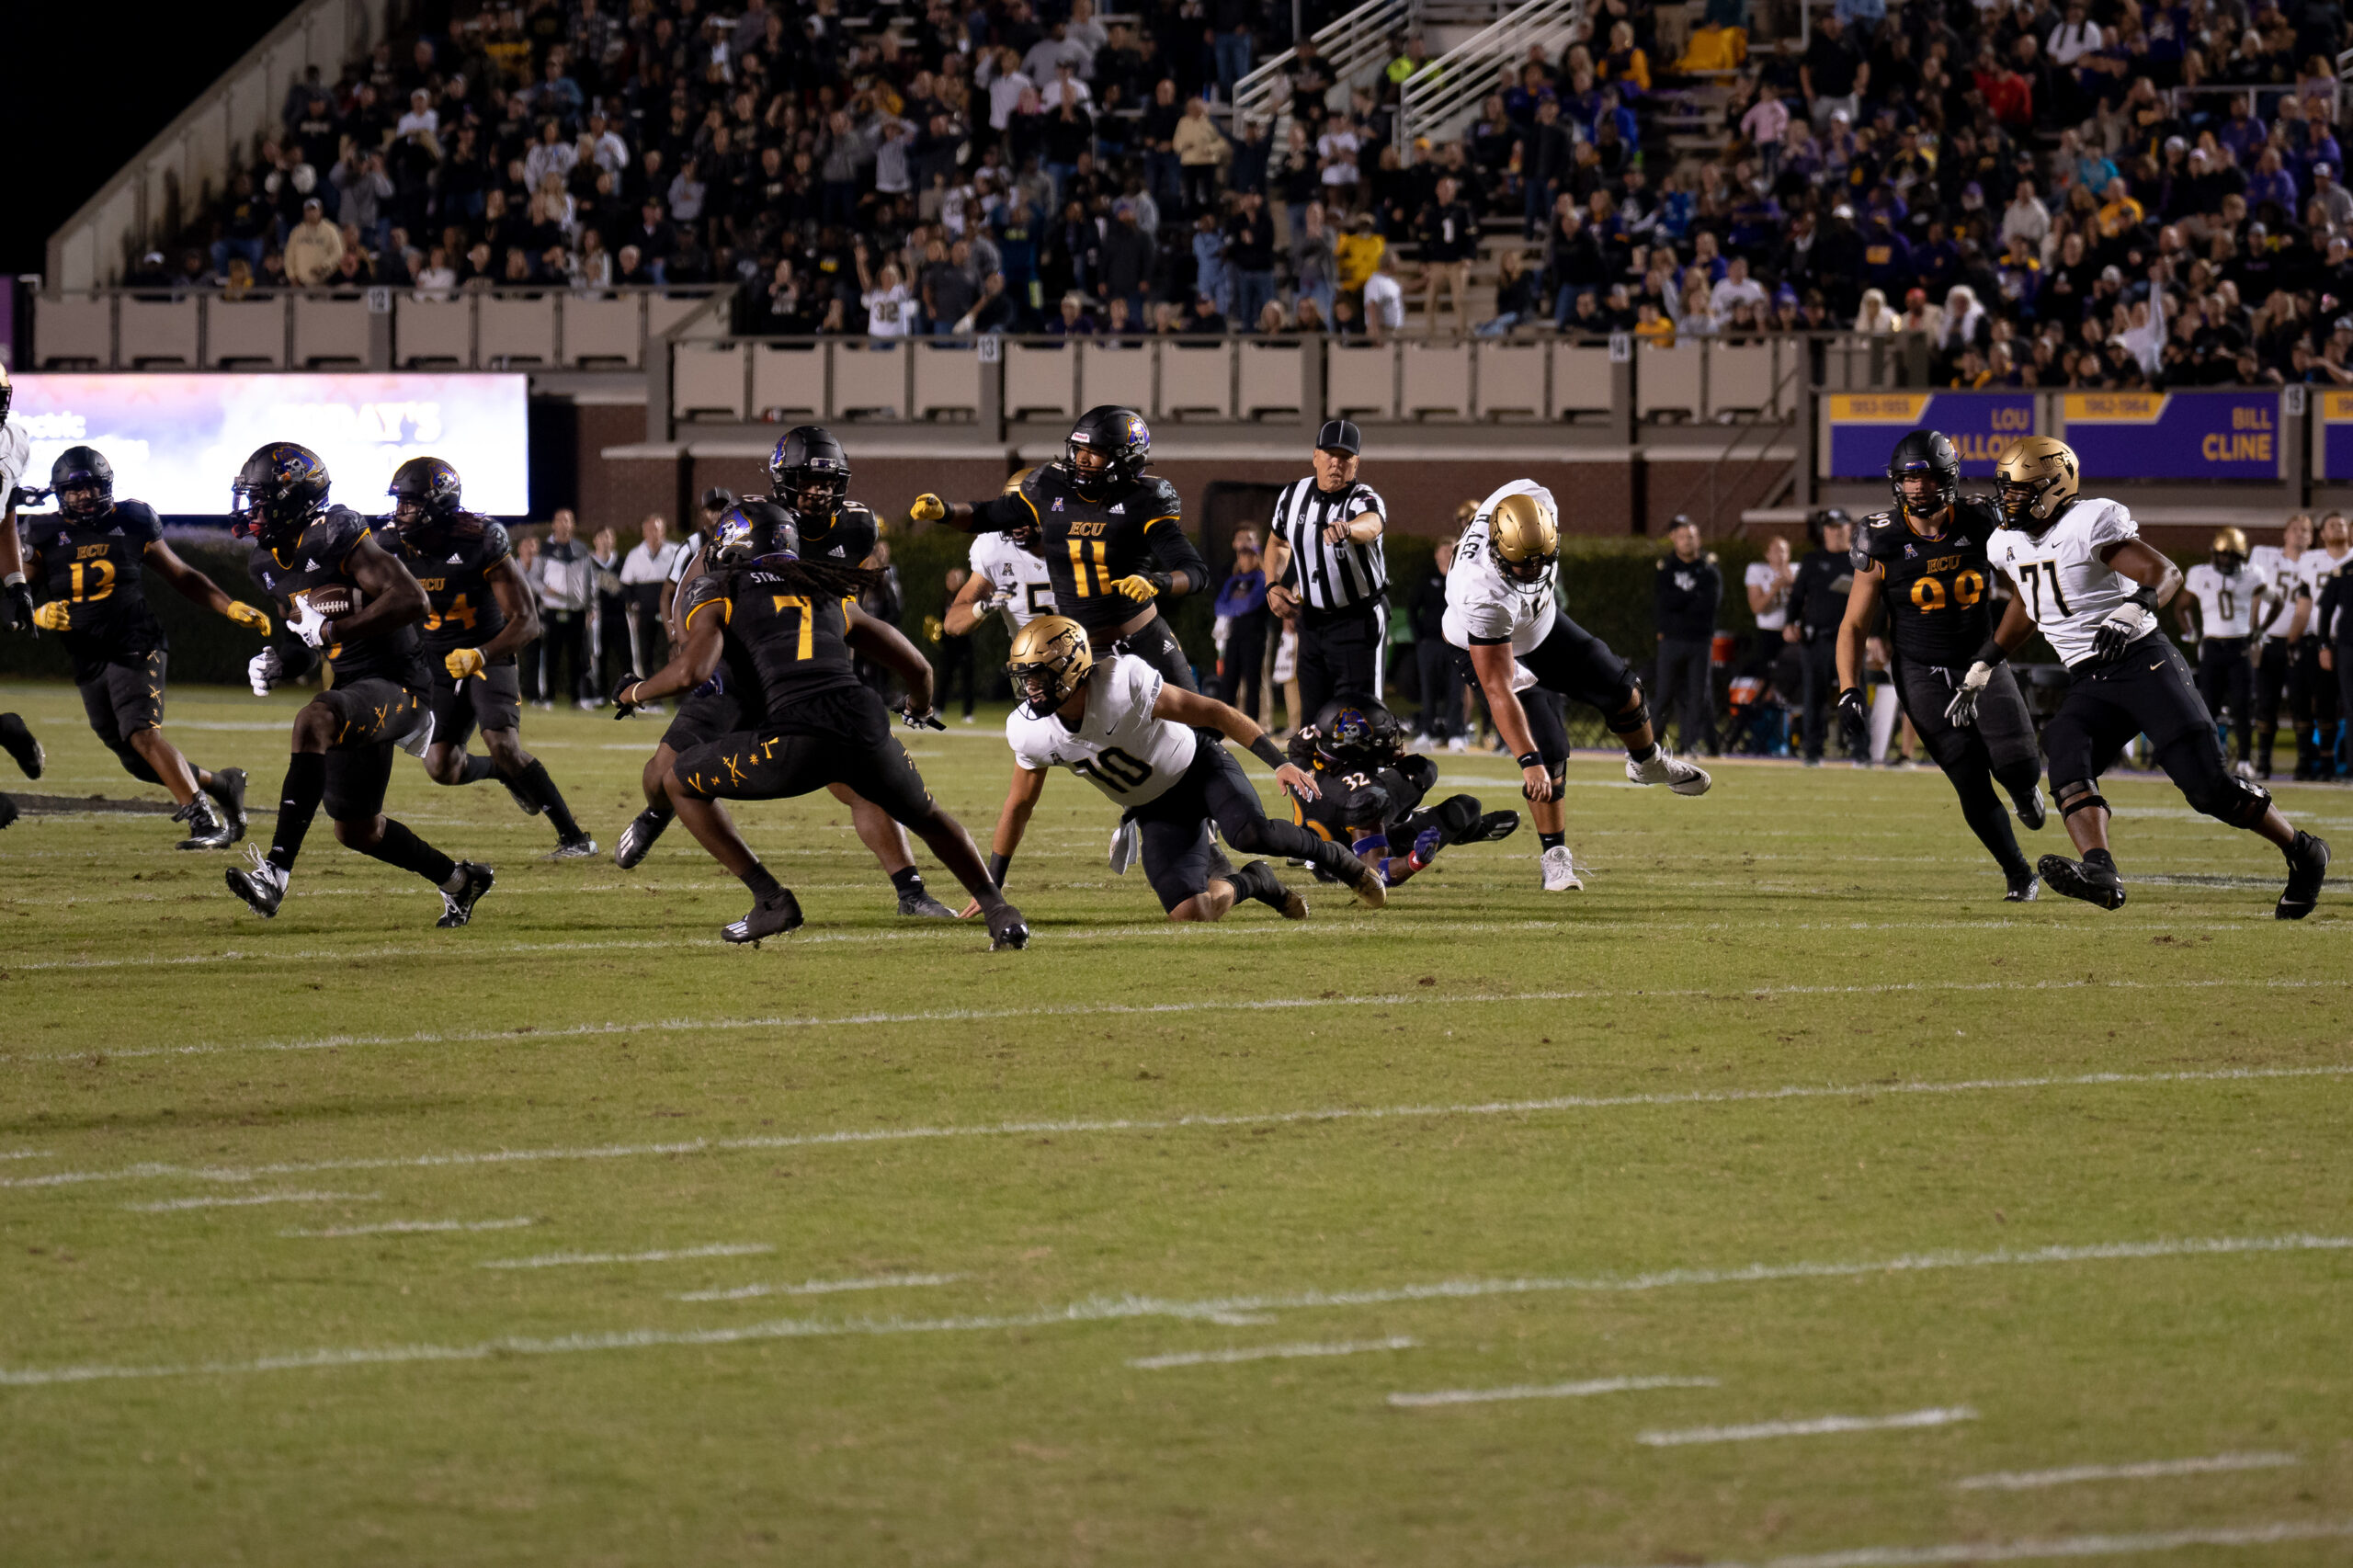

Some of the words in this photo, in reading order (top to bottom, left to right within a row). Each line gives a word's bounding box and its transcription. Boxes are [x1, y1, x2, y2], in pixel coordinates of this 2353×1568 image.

[981, 339, 994, 358] 13
[1991, 409, 2029, 430] LOU
[2233, 407, 2272, 430] BILL
[2202, 434, 2272, 462] CLINE
[1067, 522, 1107, 537] ECU
[1297, 514, 1305, 524] S
[76, 544, 109, 560] ECU
[1066, 539, 1113, 597] 11
[1927, 555, 1961, 574] ECU
[1911, 570, 1984, 615] 99
[2018, 559, 2074, 624] 71
[2218, 590, 2234, 621] 0
[773, 596, 813, 661] 7
[1074, 745, 1153, 794] 10
[1341, 772, 1370, 791] 32
